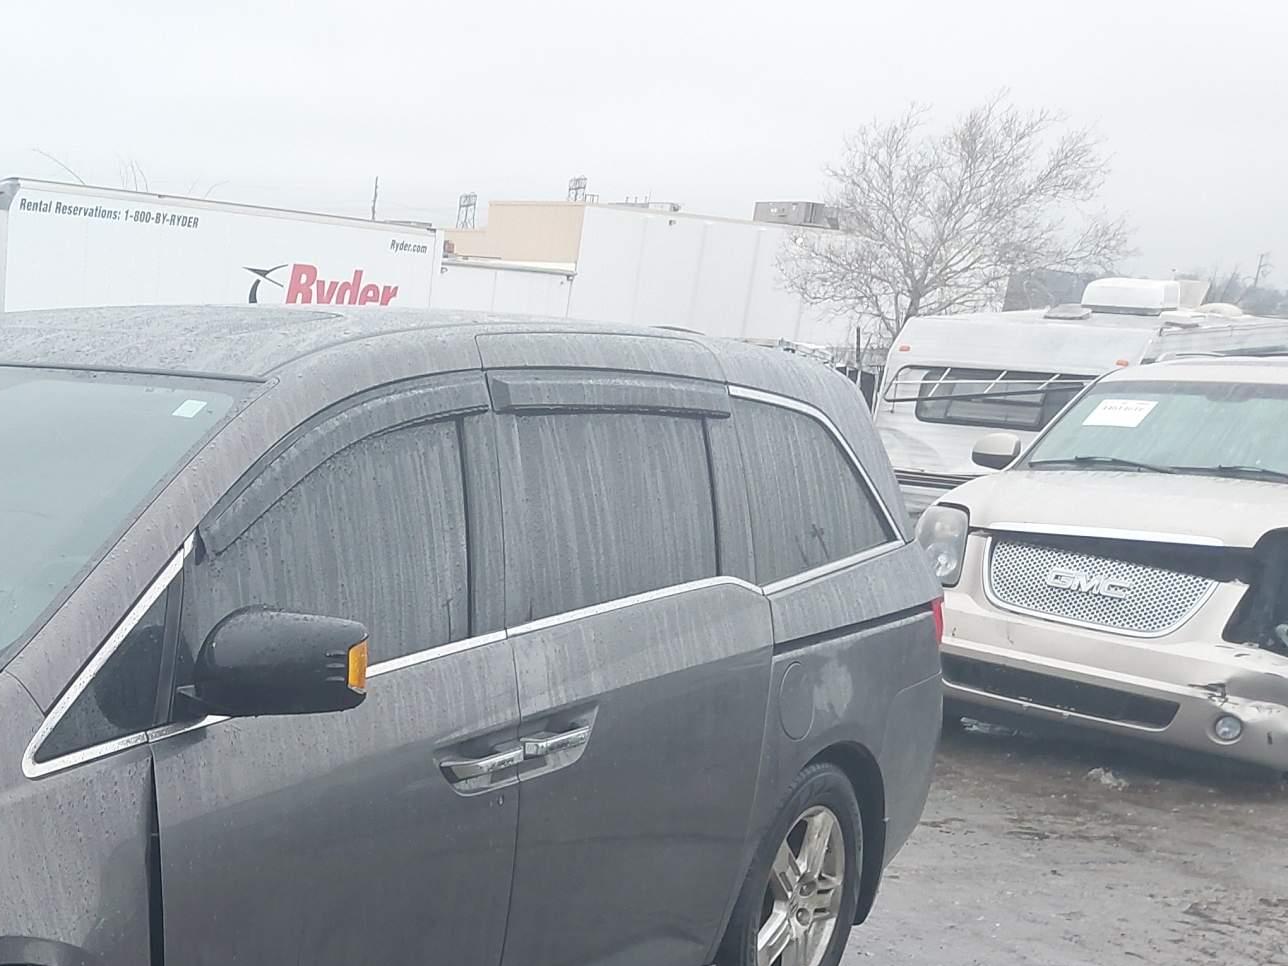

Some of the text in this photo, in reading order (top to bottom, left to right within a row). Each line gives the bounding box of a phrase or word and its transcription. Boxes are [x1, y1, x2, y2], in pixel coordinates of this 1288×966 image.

[19, 198, 200, 229] Rental Reservations: 1-800-BY-RYDER
[389, 239, 429, 254] Ryder.com
[285, 263, 399, 306] Ryder
[1045, 567, 1135, 600] GMC
